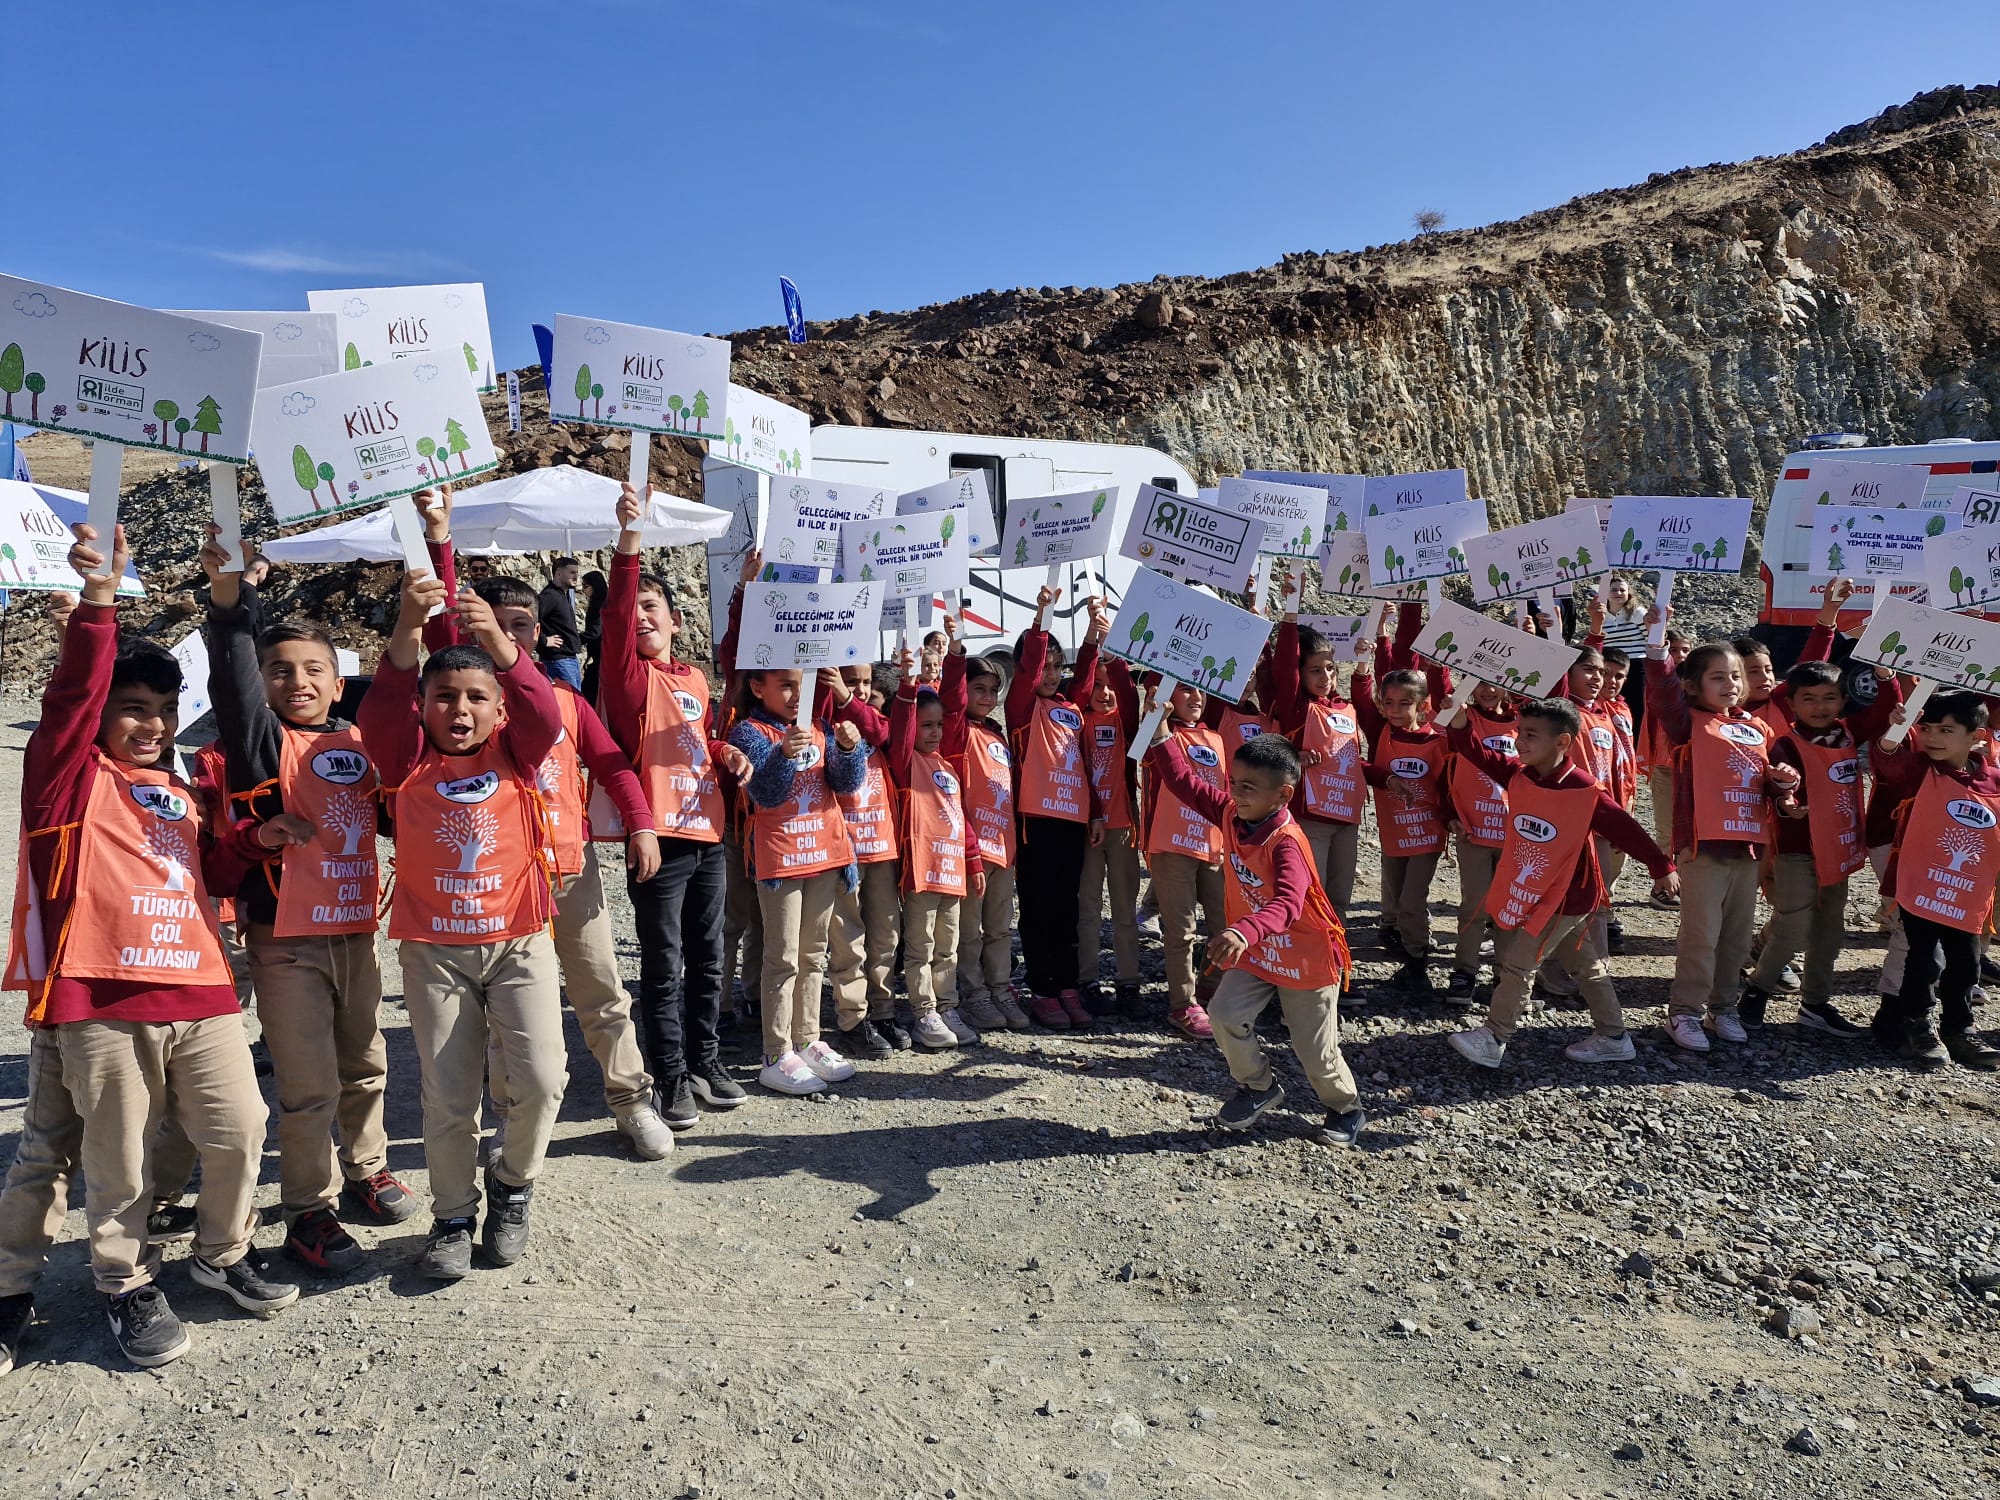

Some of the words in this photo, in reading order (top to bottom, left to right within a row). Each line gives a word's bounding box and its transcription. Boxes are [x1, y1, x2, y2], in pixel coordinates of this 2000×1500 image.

[79, 336, 150, 378] KİLİS
[623, 352, 665, 381] KİLİS
[104, 383, 125, 396] ilde
[104, 395, 141, 409] orman
[344, 400, 400, 439] KİLİS
[375, 444, 392, 455] ilde
[378, 451, 407, 463] orman
[1237, 502, 1276, 517] ORMANI
[797, 518, 806, 528] 81
[829, 522, 838, 531] 81
[1034, 520, 1060, 530] GELECEK
[1188, 512, 1218, 532] ilde
[1182, 531, 1235, 557] orman
[1850, 532, 1882, 541] GELECEK
[877, 546, 906, 557] GELECEK
[922, 549, 943, 561] DÜNYA
[1162, 551, 1181, 563] TEMA
[775, 609, 833, 621] GELECEĞİMİZ
[774, 623, 783, 633] 81
[811, 622, 820, 633] 81
[823, 621, 854, 633] ORMAN
[1489, 739, 1512, 750] TEMA
[1398, 761, 1419, 771] TEMA
[1048, 769, 1082, 788] TÜRKİYE
[1723, 788, 1761, 805] TÜRKİYE
[1393, 809, 1433, 825] TÜRKİYE
[1957, 803, 1984, 820] TEMA
[1521, 815, 1542, 832] TEMA
[855, 839, 889, 855] MASIN
[320, 857, 375, 878] TÜRKİYE
[433, 872, 503, 895] TÜRKİYE
[1926, 867, 1976, 892] TÜRKİYE
[130, 891, 200, 920] TÜRKİY
[312, 902, 373, 923] OLMASIN
[451, 895, 485, 917] ÇÖL
[1914, 894, 1967, 921] OLMASIN
[150, 918, 184, 946] ÇÖL
[431, 916, 505, 935] OLMASIN
[119, 946, 201, 970] OLMASIN
